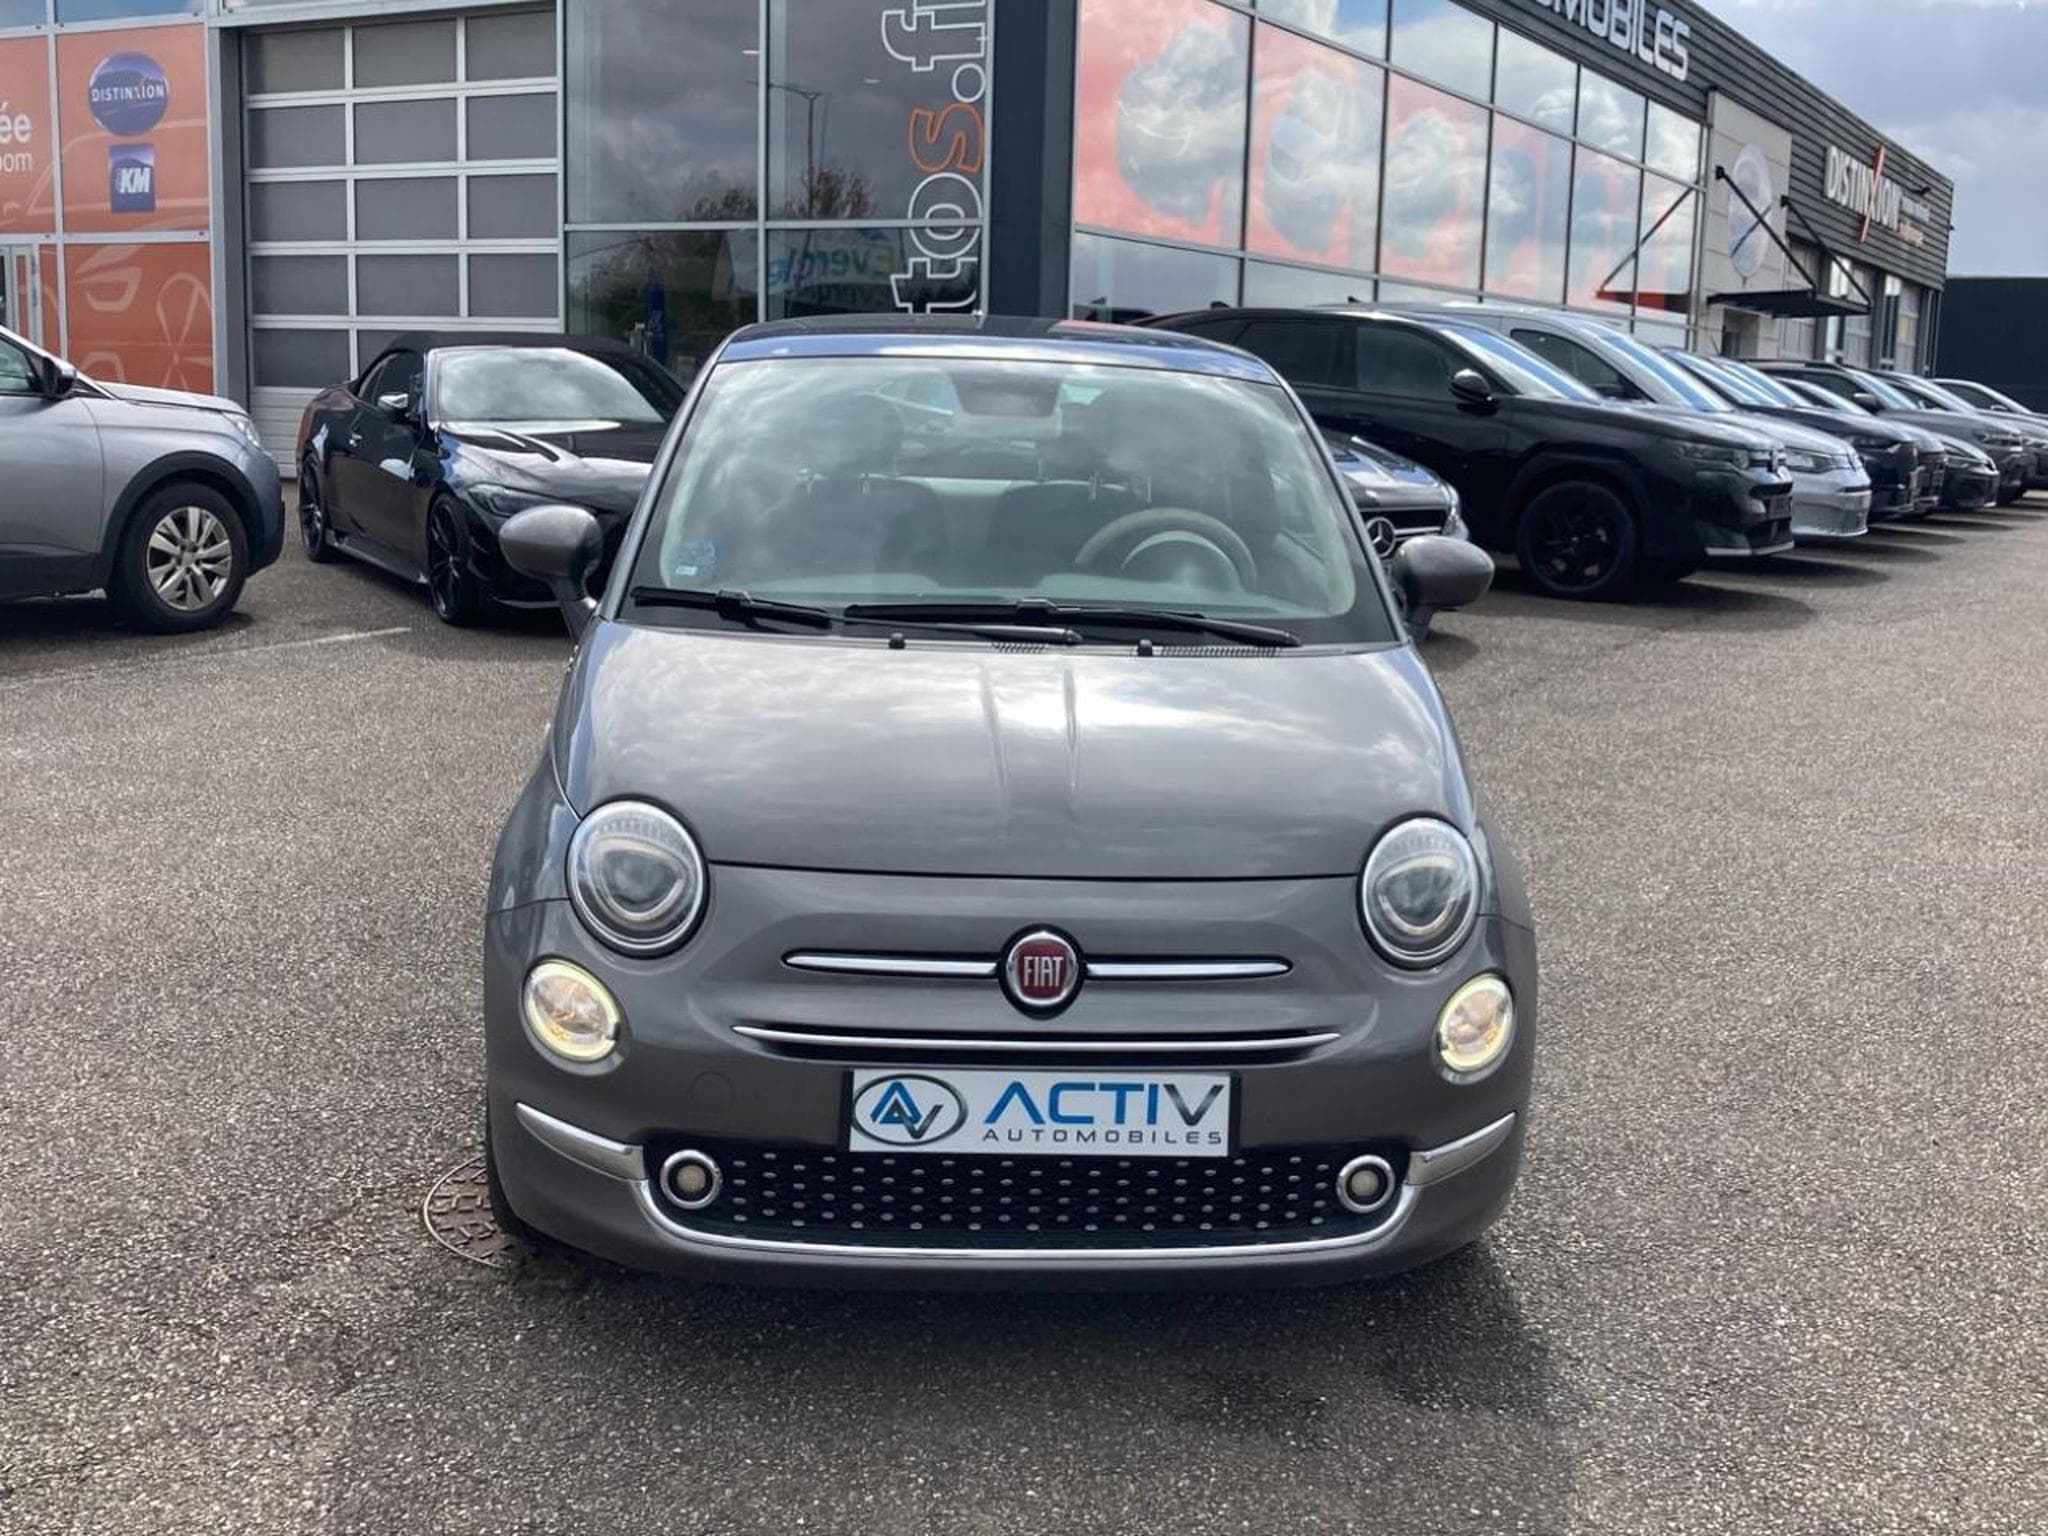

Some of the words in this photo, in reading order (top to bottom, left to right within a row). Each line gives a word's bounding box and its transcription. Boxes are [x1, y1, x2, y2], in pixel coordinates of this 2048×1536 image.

[881, 0, 986, 314] tos.f
[1023, 955, 1064, 987] FIAT
[983, 1081, 1225, 1126] ACTIV
[983, 1128, 1222, 1145] AUTOMOBILES
